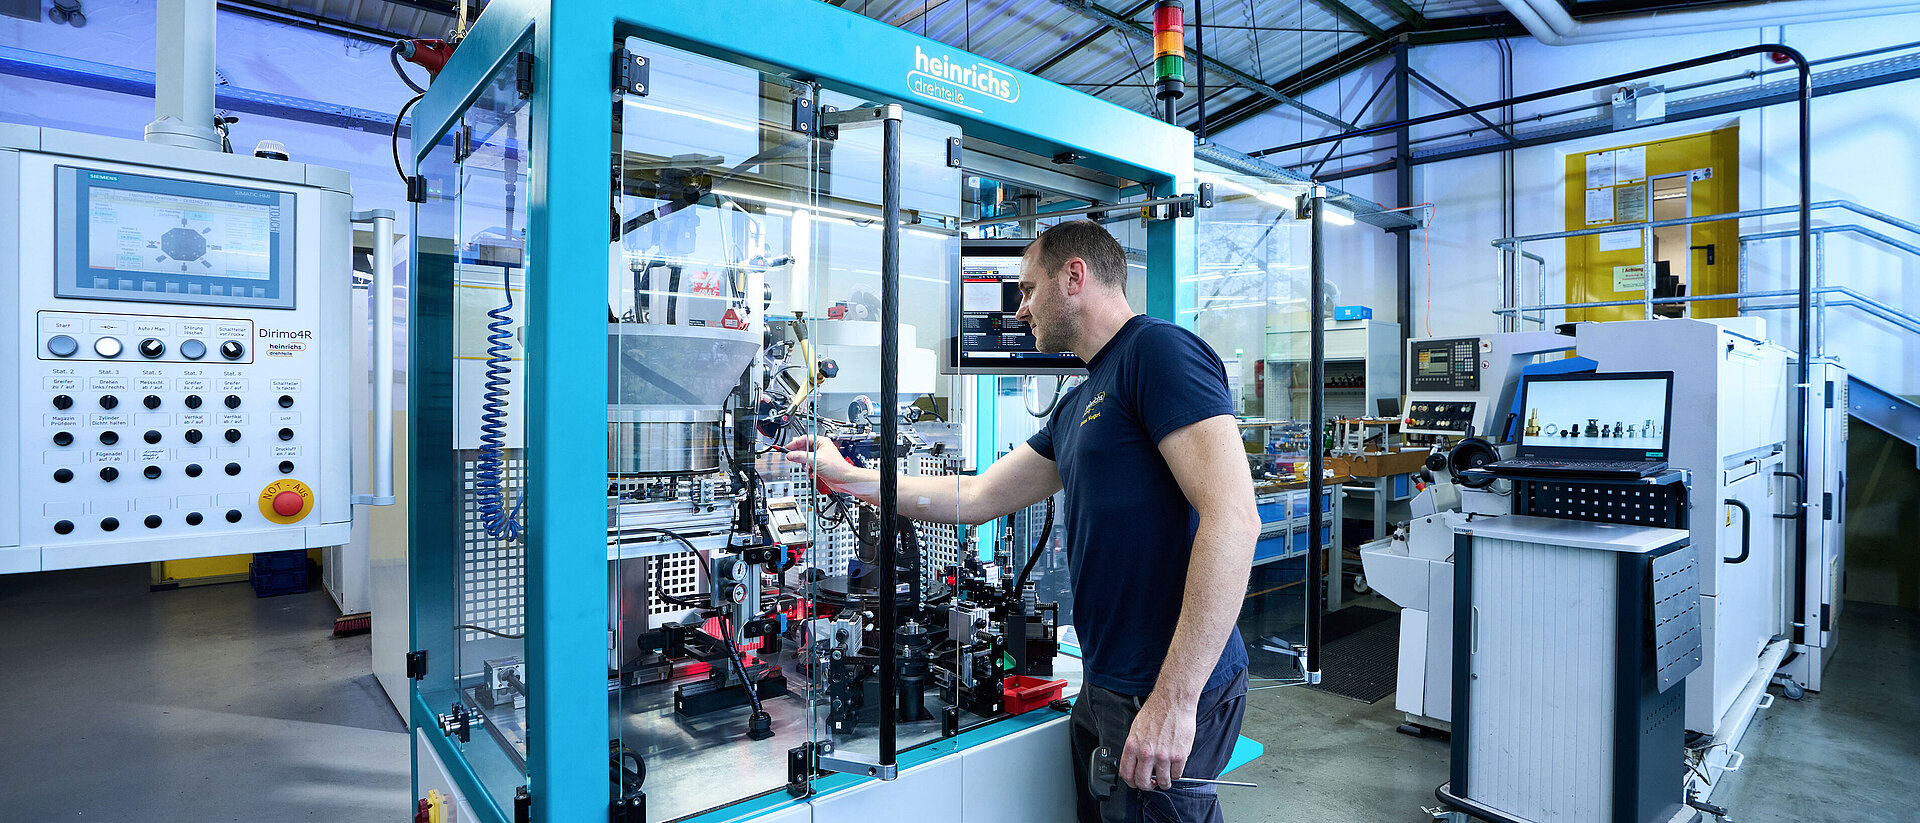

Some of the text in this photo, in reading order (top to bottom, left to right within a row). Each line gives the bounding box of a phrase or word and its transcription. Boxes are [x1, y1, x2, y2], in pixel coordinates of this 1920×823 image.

[915, 45, 1010, 99] heinrichs
[914, 77, 965, 104] drehteile
[89, 173, 118, 181] SIEMENS
[234, 190, 258, 198] SIMATIC
[270, 206, 280, 233] TOUCH
[259, 328, 313, 340] Dirimo4R
[262, 482, 282, 500] NOT
